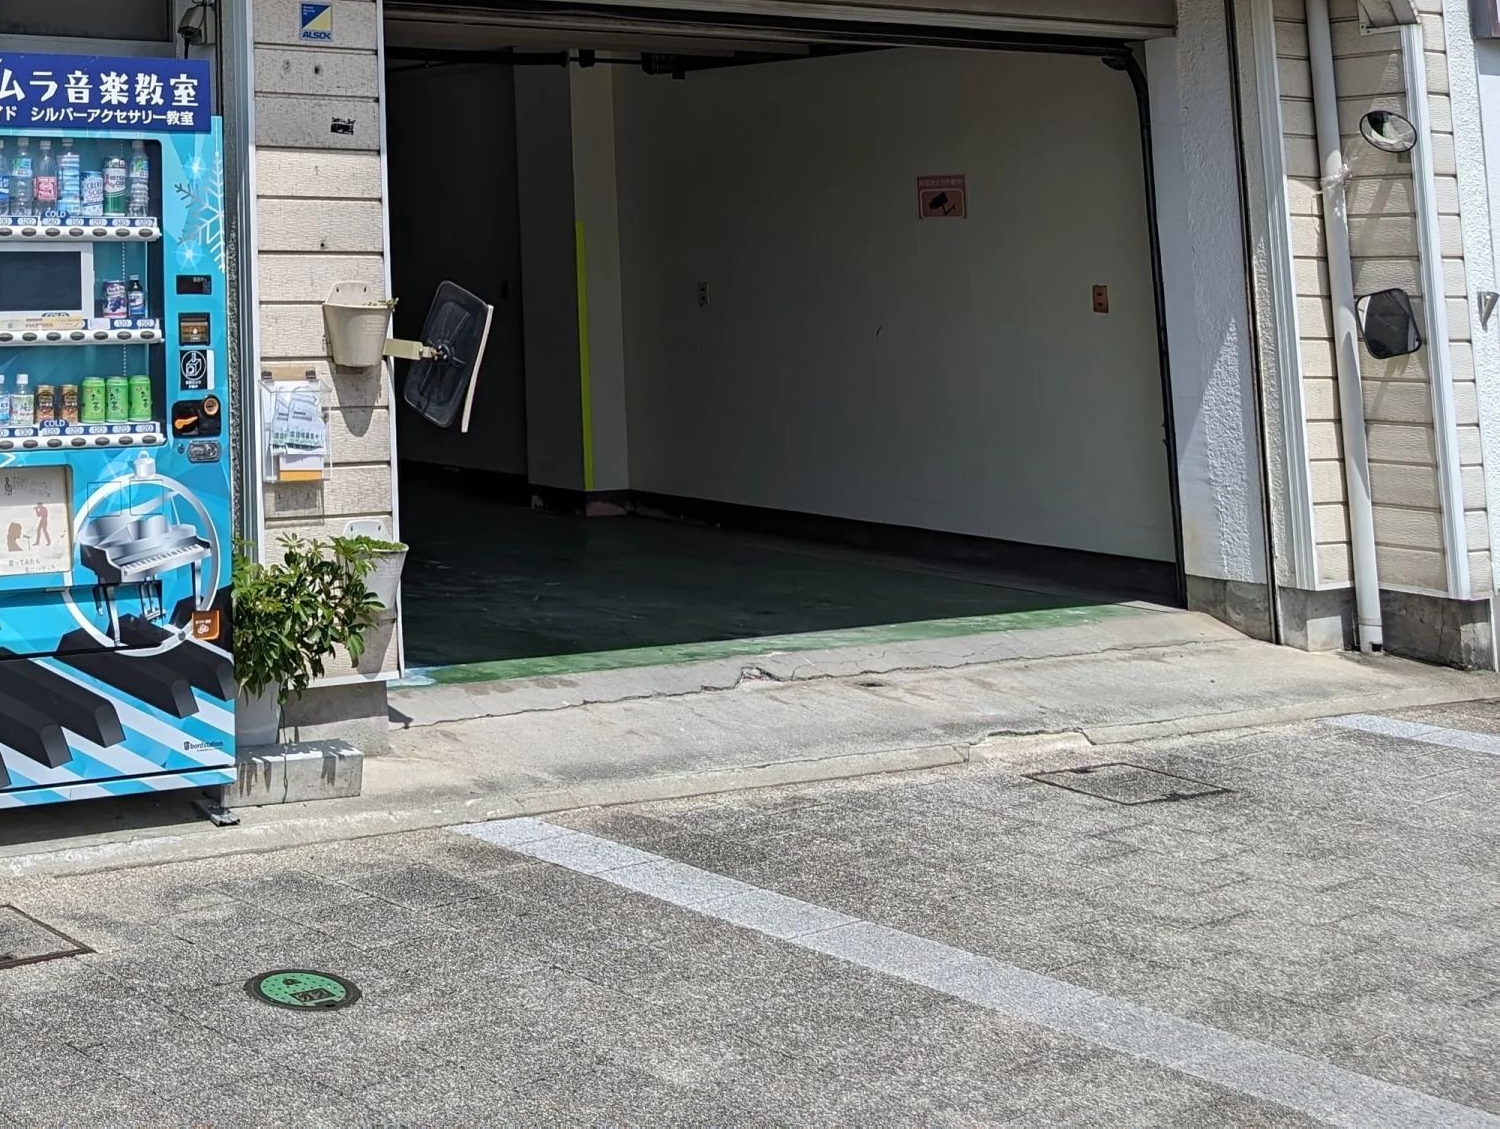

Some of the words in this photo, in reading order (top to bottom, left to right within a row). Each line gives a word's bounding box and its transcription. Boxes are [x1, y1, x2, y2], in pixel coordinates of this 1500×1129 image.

[302, 31, 331, 40] ALSOK
[30, 107, 194, 126] シルバーアクセサリー教室
[45, 210, 66, 218] COLD
[43, 420, 66, 428] COLD
